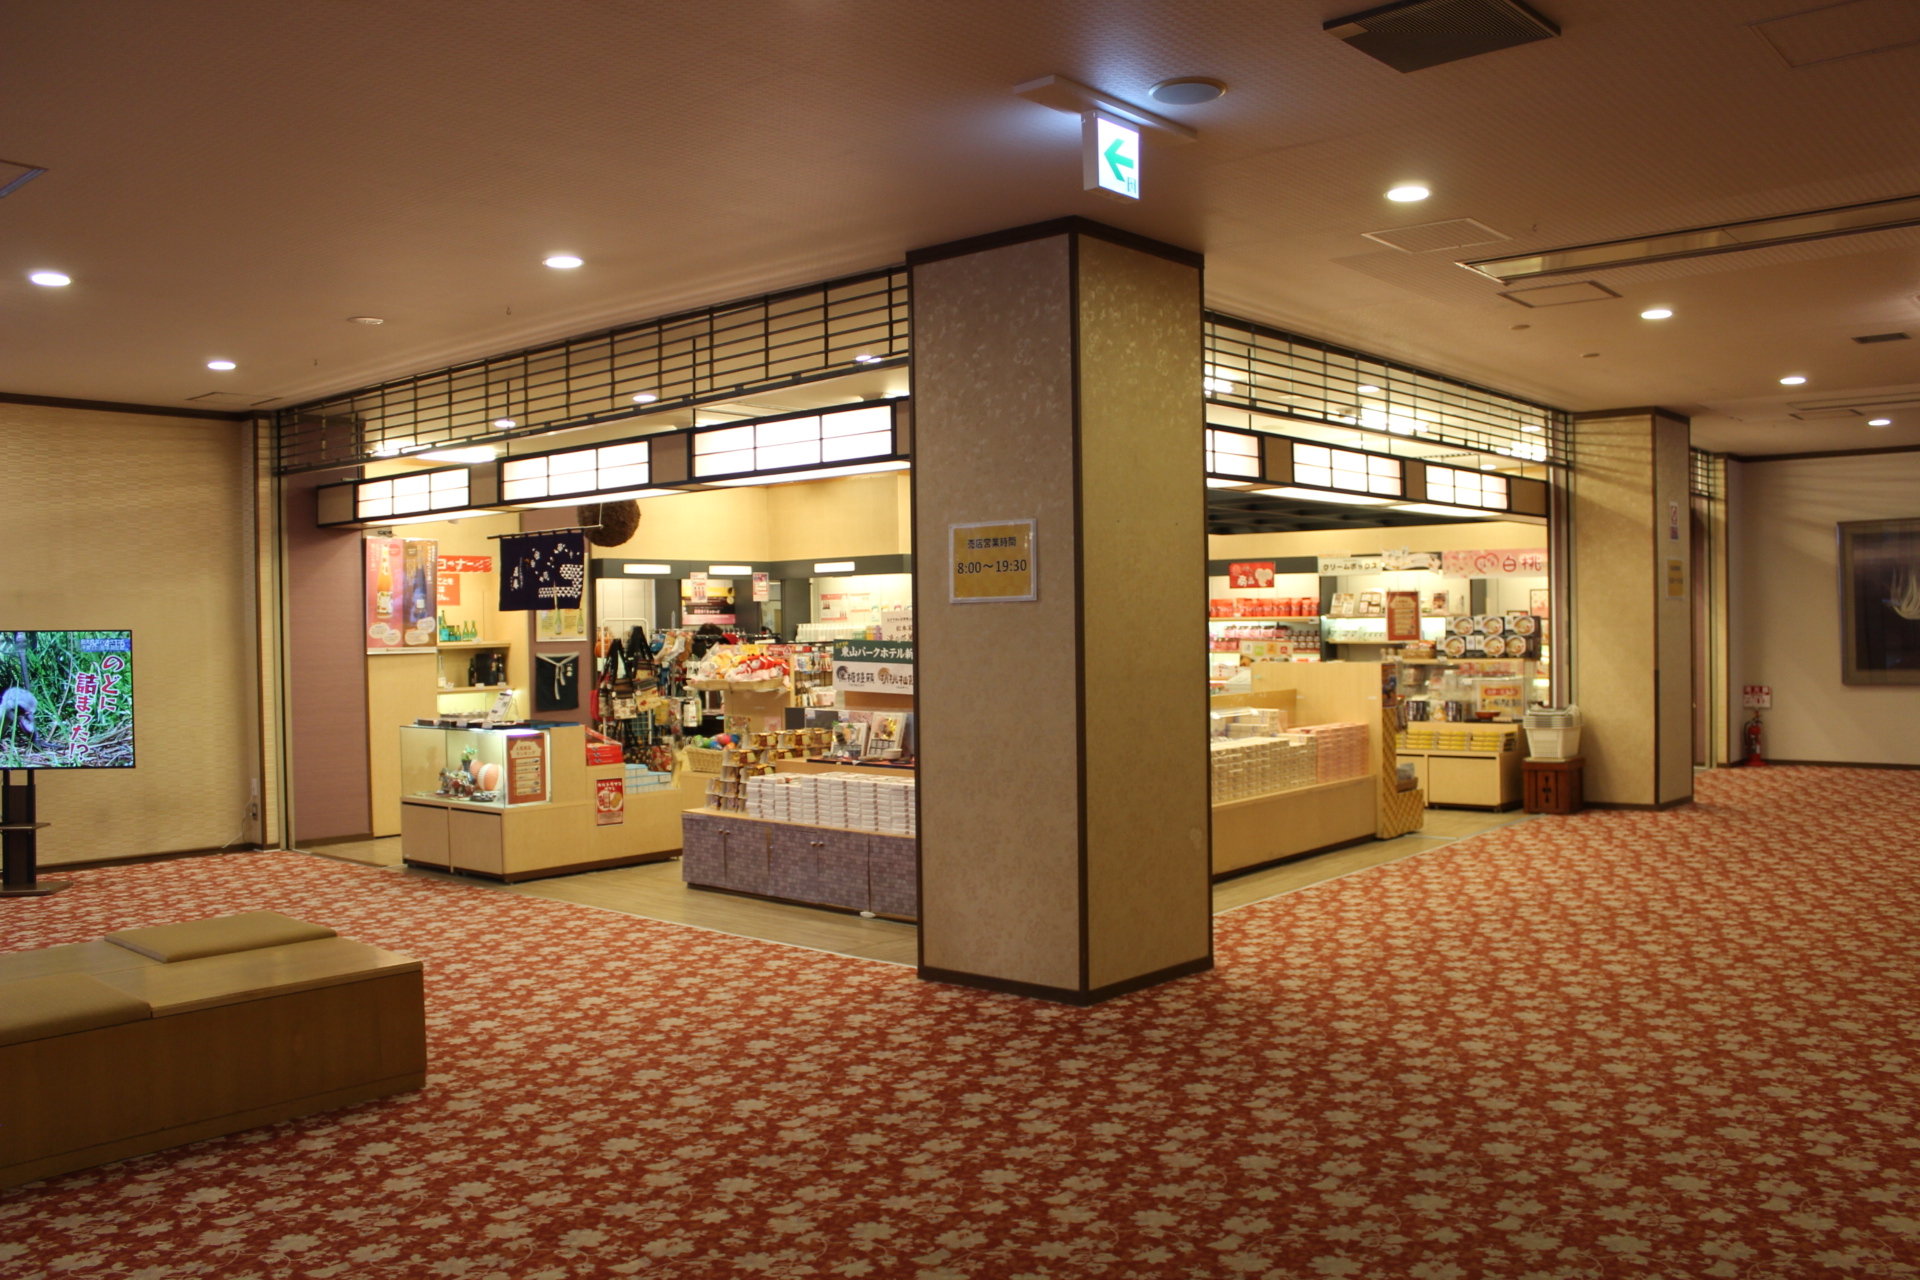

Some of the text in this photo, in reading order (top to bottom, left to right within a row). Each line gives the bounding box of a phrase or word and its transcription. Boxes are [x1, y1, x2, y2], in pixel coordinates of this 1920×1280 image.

[967, 537, 1017, 548] 売店営業時間
[1323, 562, 1378, 572] クリームボックス
[1502, 555, 1542, 573] 白桃
[99, 655, 124, 711] のどに
